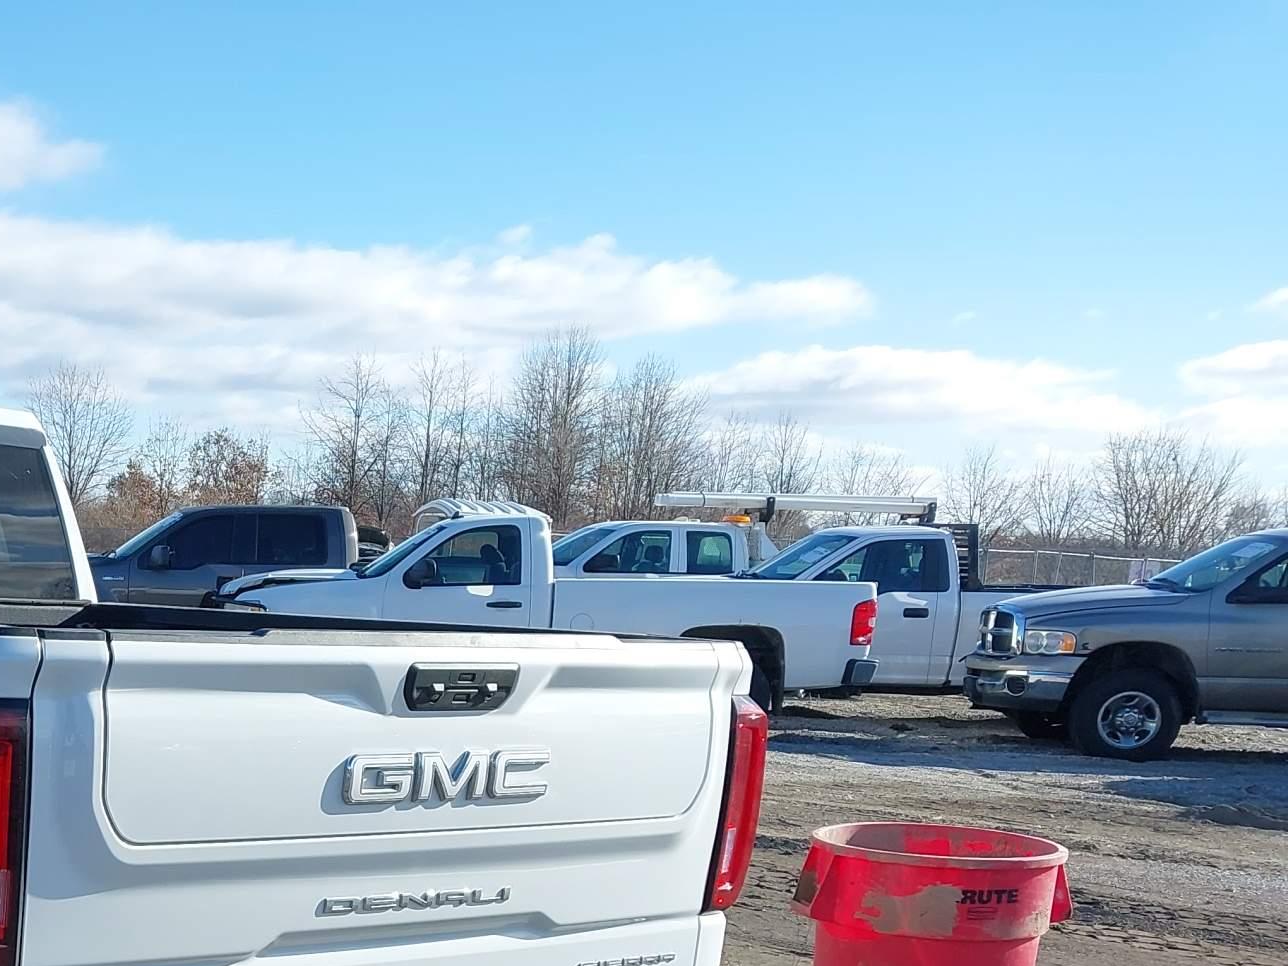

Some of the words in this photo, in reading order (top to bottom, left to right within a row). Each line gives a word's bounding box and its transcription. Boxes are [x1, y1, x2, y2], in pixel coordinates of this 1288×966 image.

[343, 750, 550, 804] GMC
[319, 886, 511, 916] DENALI
[956, 889, 1018, 904] RUTE
